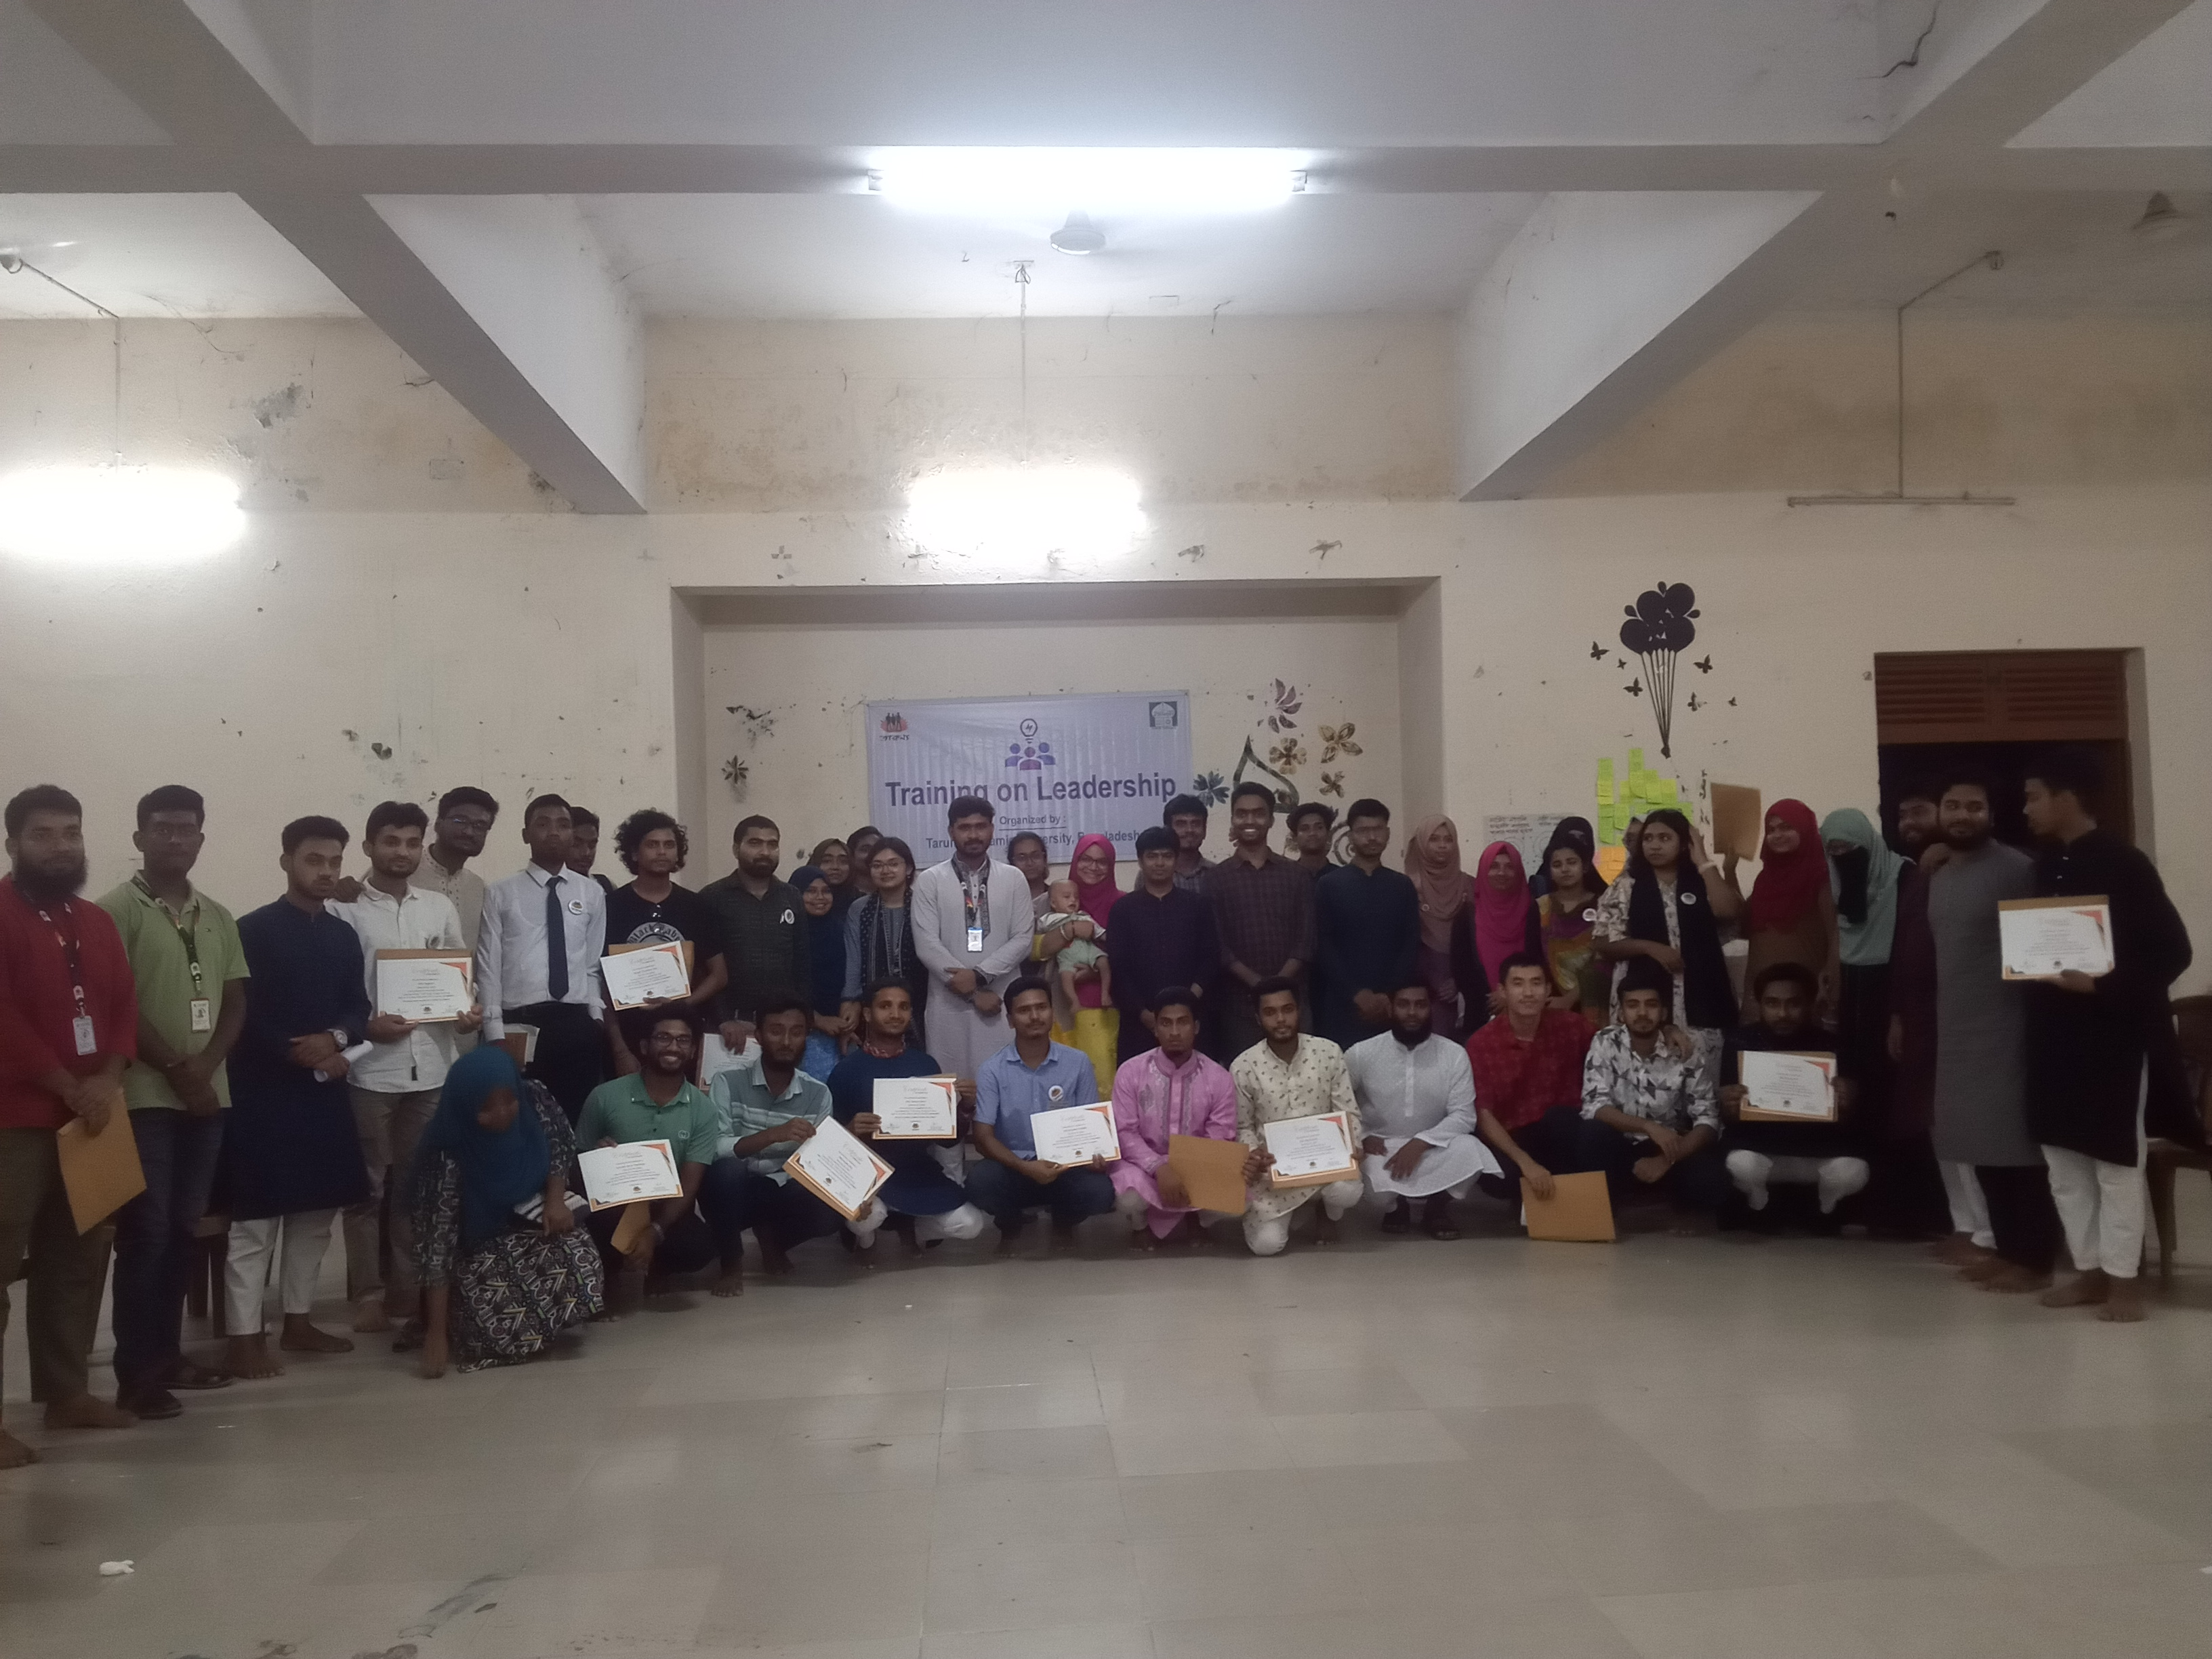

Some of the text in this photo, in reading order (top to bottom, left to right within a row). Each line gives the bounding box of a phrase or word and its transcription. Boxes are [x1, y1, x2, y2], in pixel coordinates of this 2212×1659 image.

[885, 772, 1176, 806] Training on Leadership
[1000, 815, 1046, 826] Organized
[1050, 815, 1061, 825] by
[926, 838, 956, 848] Tarun
[1041, 832, 1075, 846] ersity,
